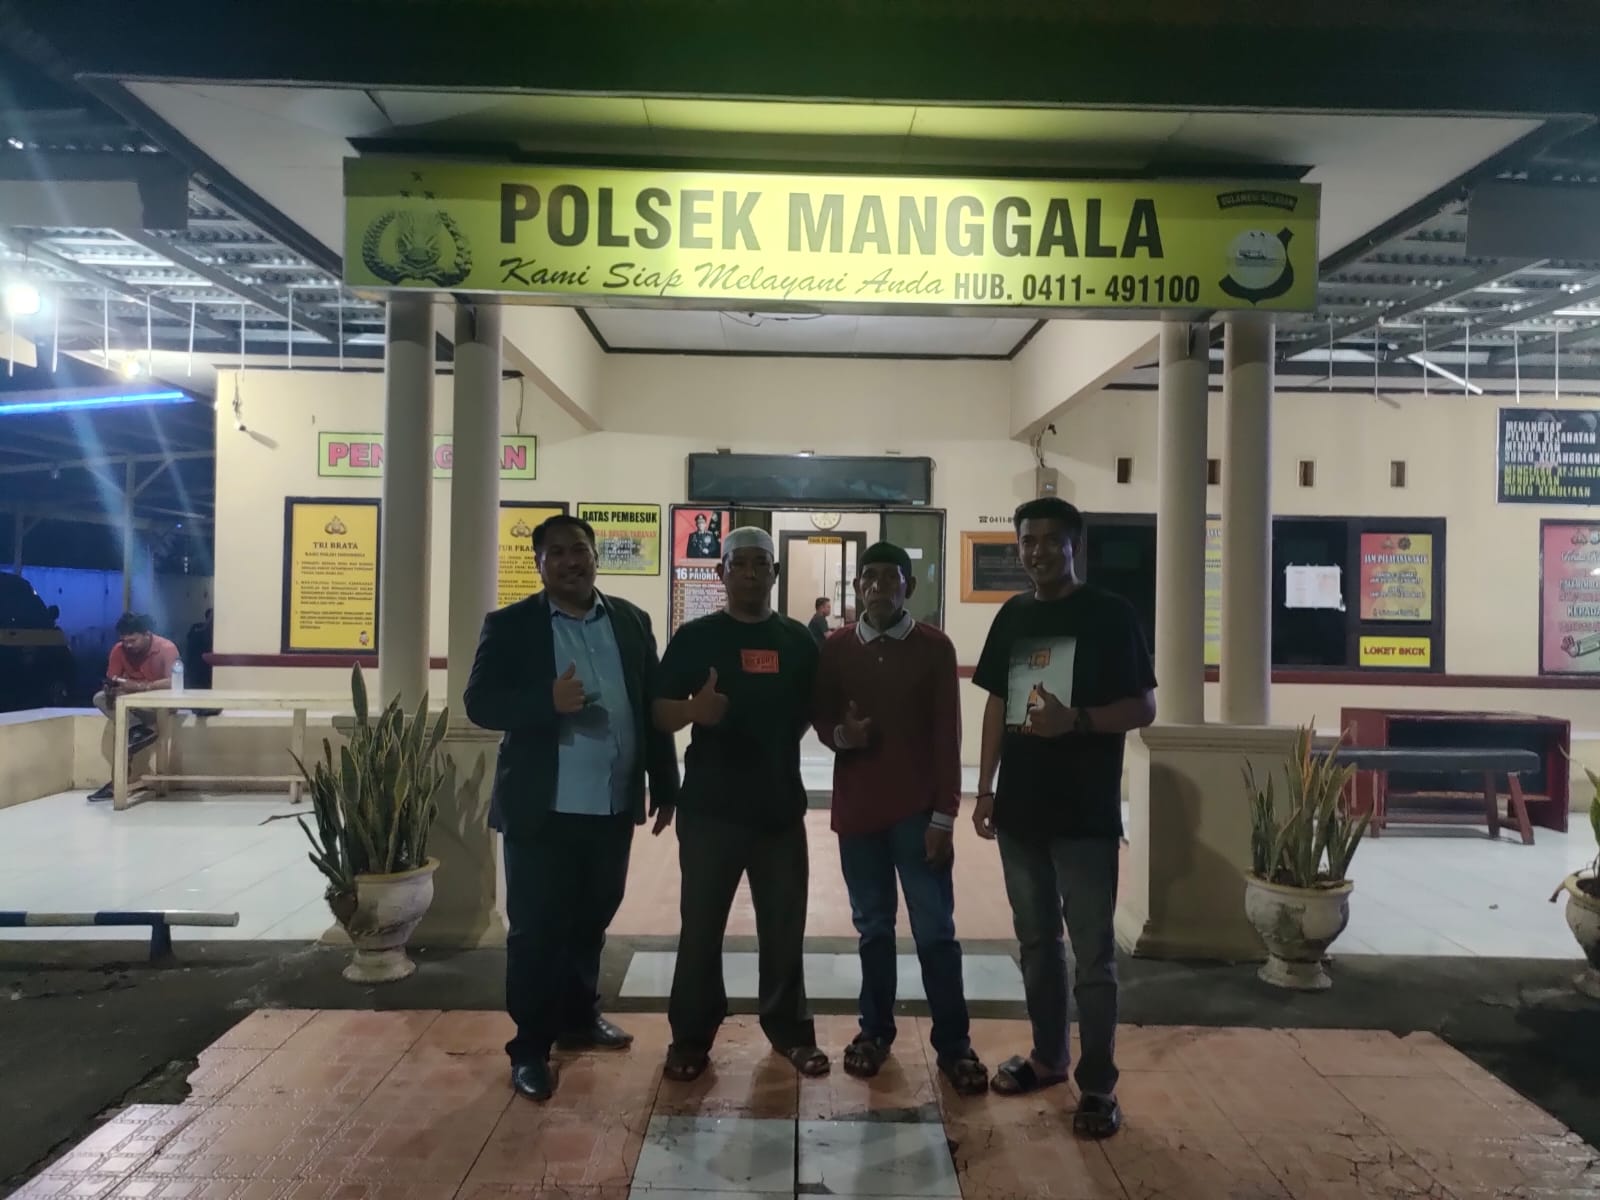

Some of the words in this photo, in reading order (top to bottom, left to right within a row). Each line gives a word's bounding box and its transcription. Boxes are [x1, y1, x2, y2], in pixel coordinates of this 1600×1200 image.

[500, 182, 762, 252] POLSEK
[788, 192, 1165, 259] MANGGALA
[499, 256, 592, 286] Kami
[602, 262, 685, 297] Siap
[694, 262, 849, 304] Melayani
[854, 267, 945, 297] Anda
[954, 272, 1012, 300] HUB.
[1022, 274, 1096, 301] 0411-
[1104, 275, 1200, 302] 491100
[1505, 421, 1562, 433] MENANGKAP
[1543, 432, 1596, 444] KEJAHATAN
[327, 441, 528, 471] PENGN
[611, 511, 658, 523] PEMBESUK
[313, 541, 328, 549] TRI
[330, 542, 359, 550] BRATA
[676, 567, 688, 580] 16
[1363, 646, 1396, 655] LOKET
